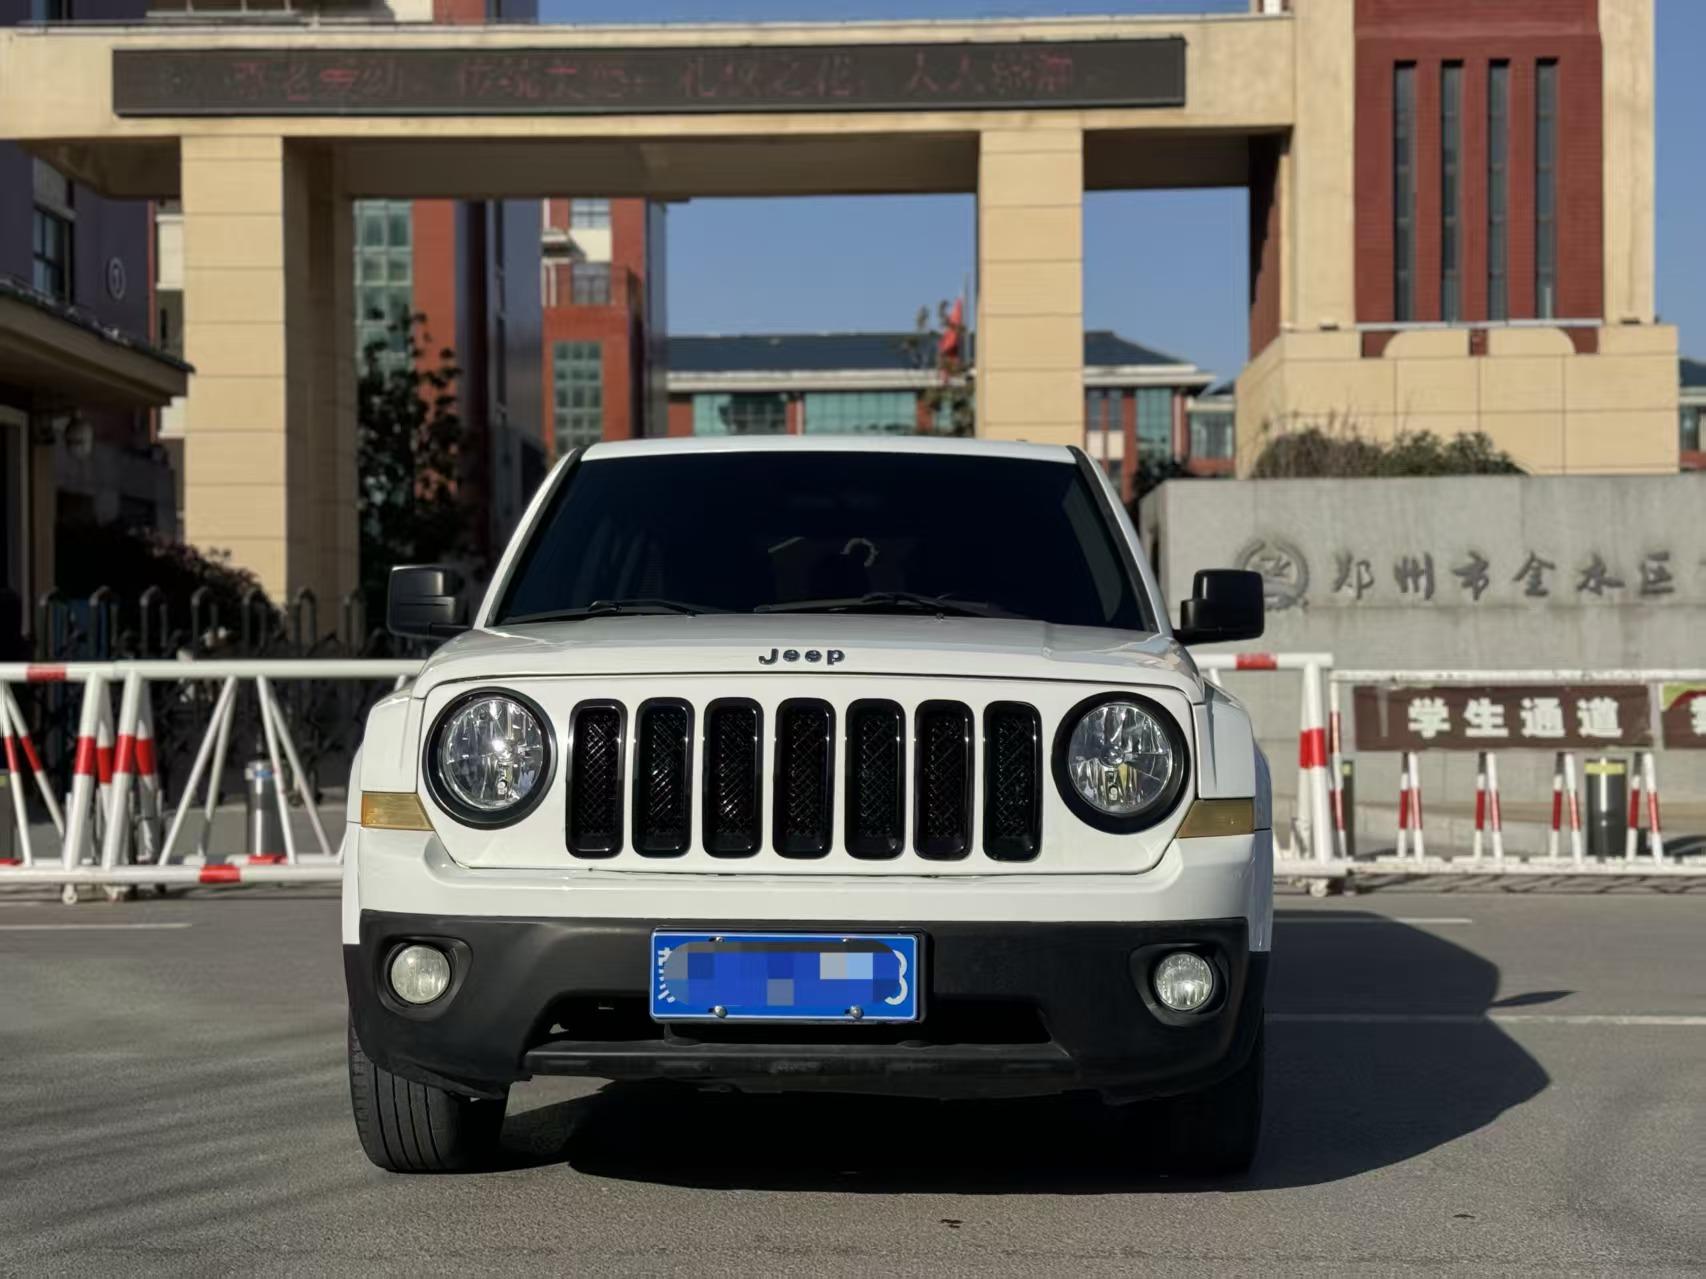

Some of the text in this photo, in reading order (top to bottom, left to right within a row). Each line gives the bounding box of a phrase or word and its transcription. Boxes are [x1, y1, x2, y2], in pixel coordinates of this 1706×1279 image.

[1334, 549, 1706, 600] 郑州市金水区
[758, 647, 845, 666] Jeep
[1407, 696, 1623, 739] 学生通道
